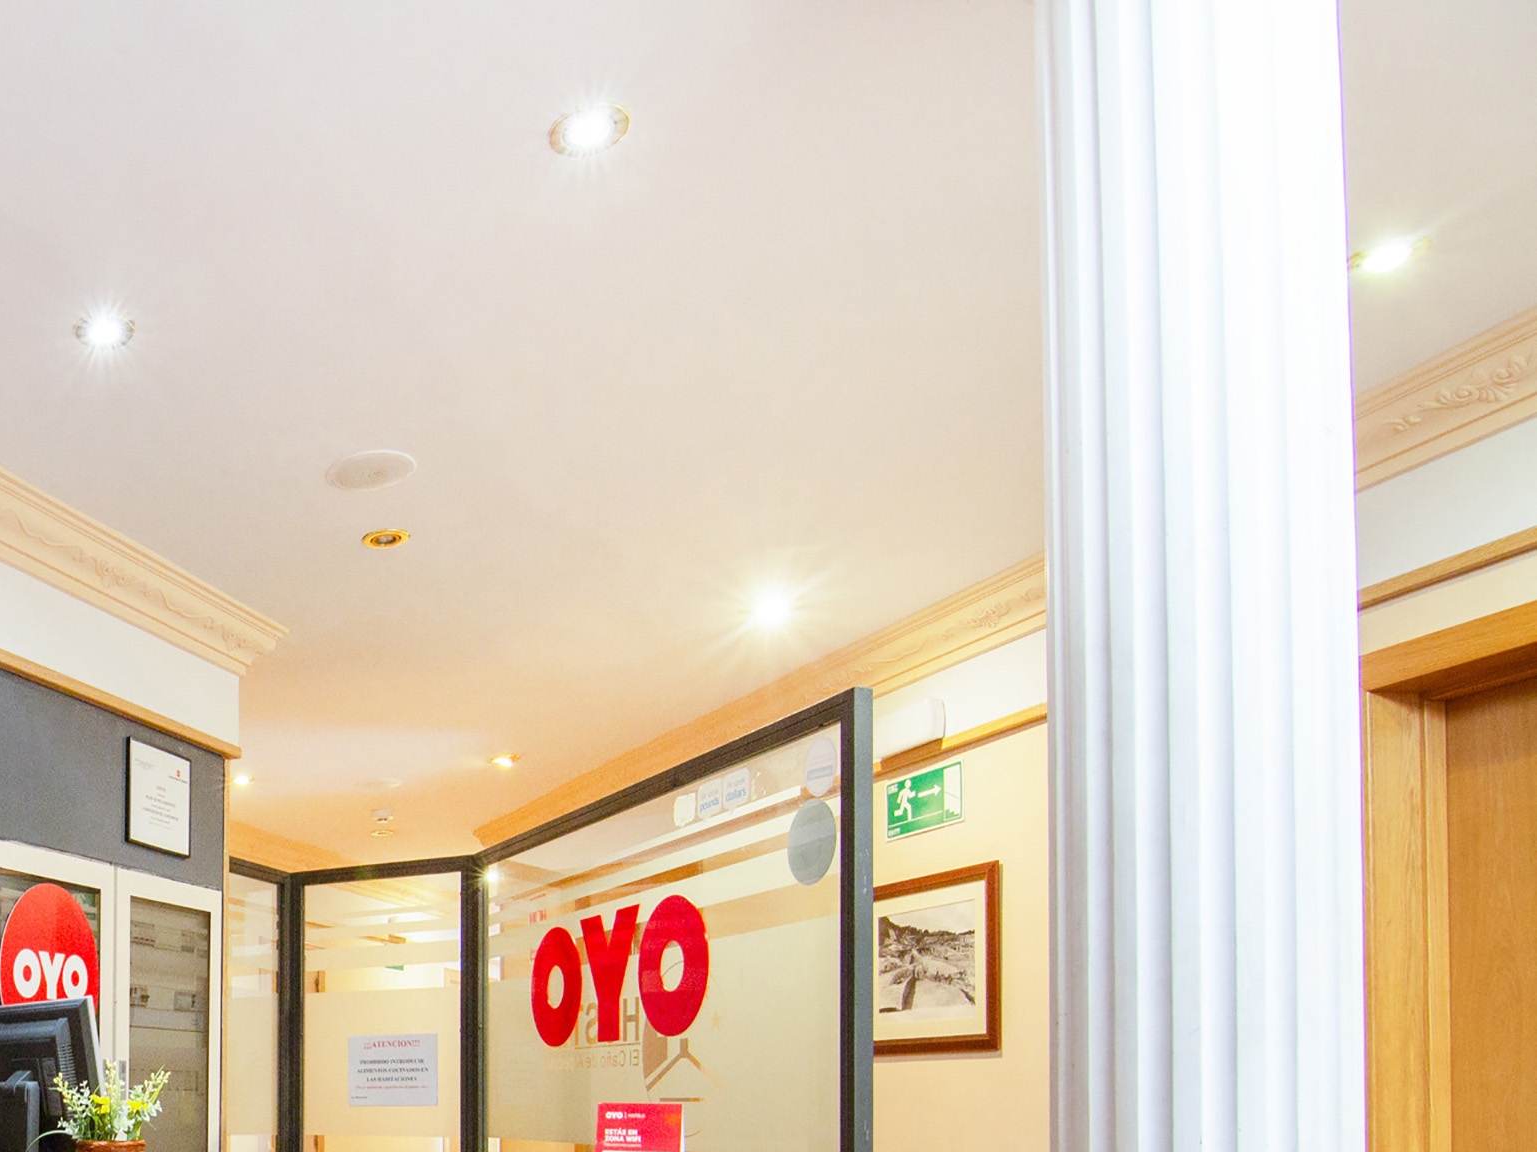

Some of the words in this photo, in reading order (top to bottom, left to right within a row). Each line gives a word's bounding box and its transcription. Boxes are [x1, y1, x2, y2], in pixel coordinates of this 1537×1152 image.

[13, 948, 89, 1000] OYO
[531, 894, 710, 1048] OYO
[605, 1111, 623, 1119] OYO
[627, 1128, 639, 1136] EN
